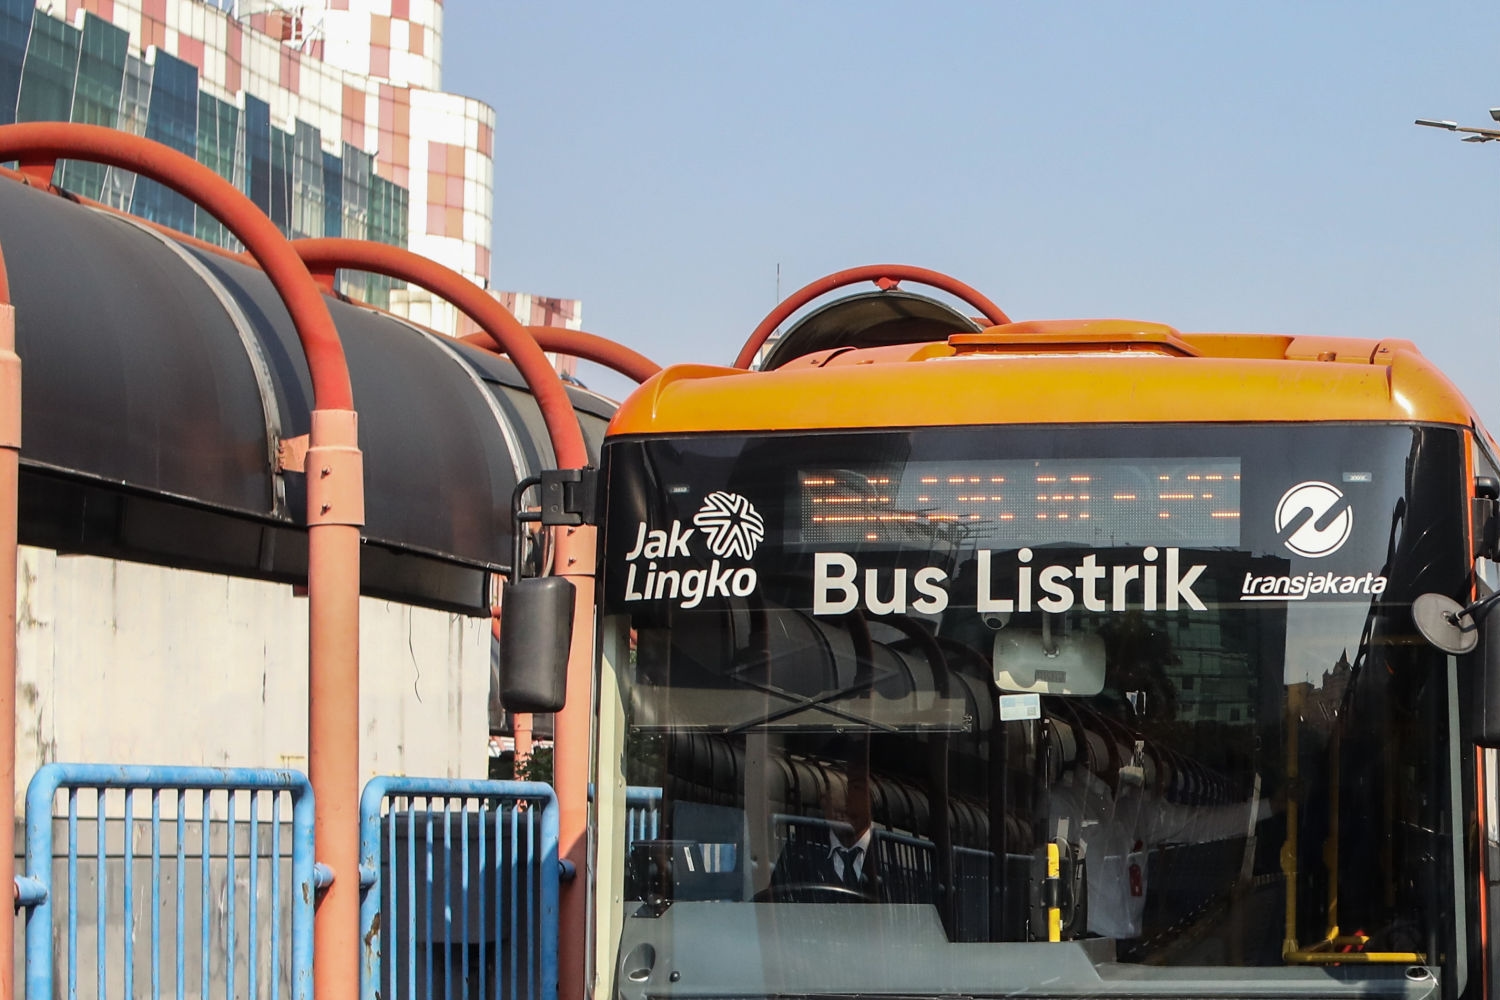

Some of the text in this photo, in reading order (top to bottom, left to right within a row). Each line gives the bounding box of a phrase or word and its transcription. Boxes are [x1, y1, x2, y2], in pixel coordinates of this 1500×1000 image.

[625, 519, 695, 561] Jak
[624, 560, 757, 609] Lingko
[813, 546, 1208, 615] Bus Listrik
[1240, 571, 1388, 601] transjakarta
